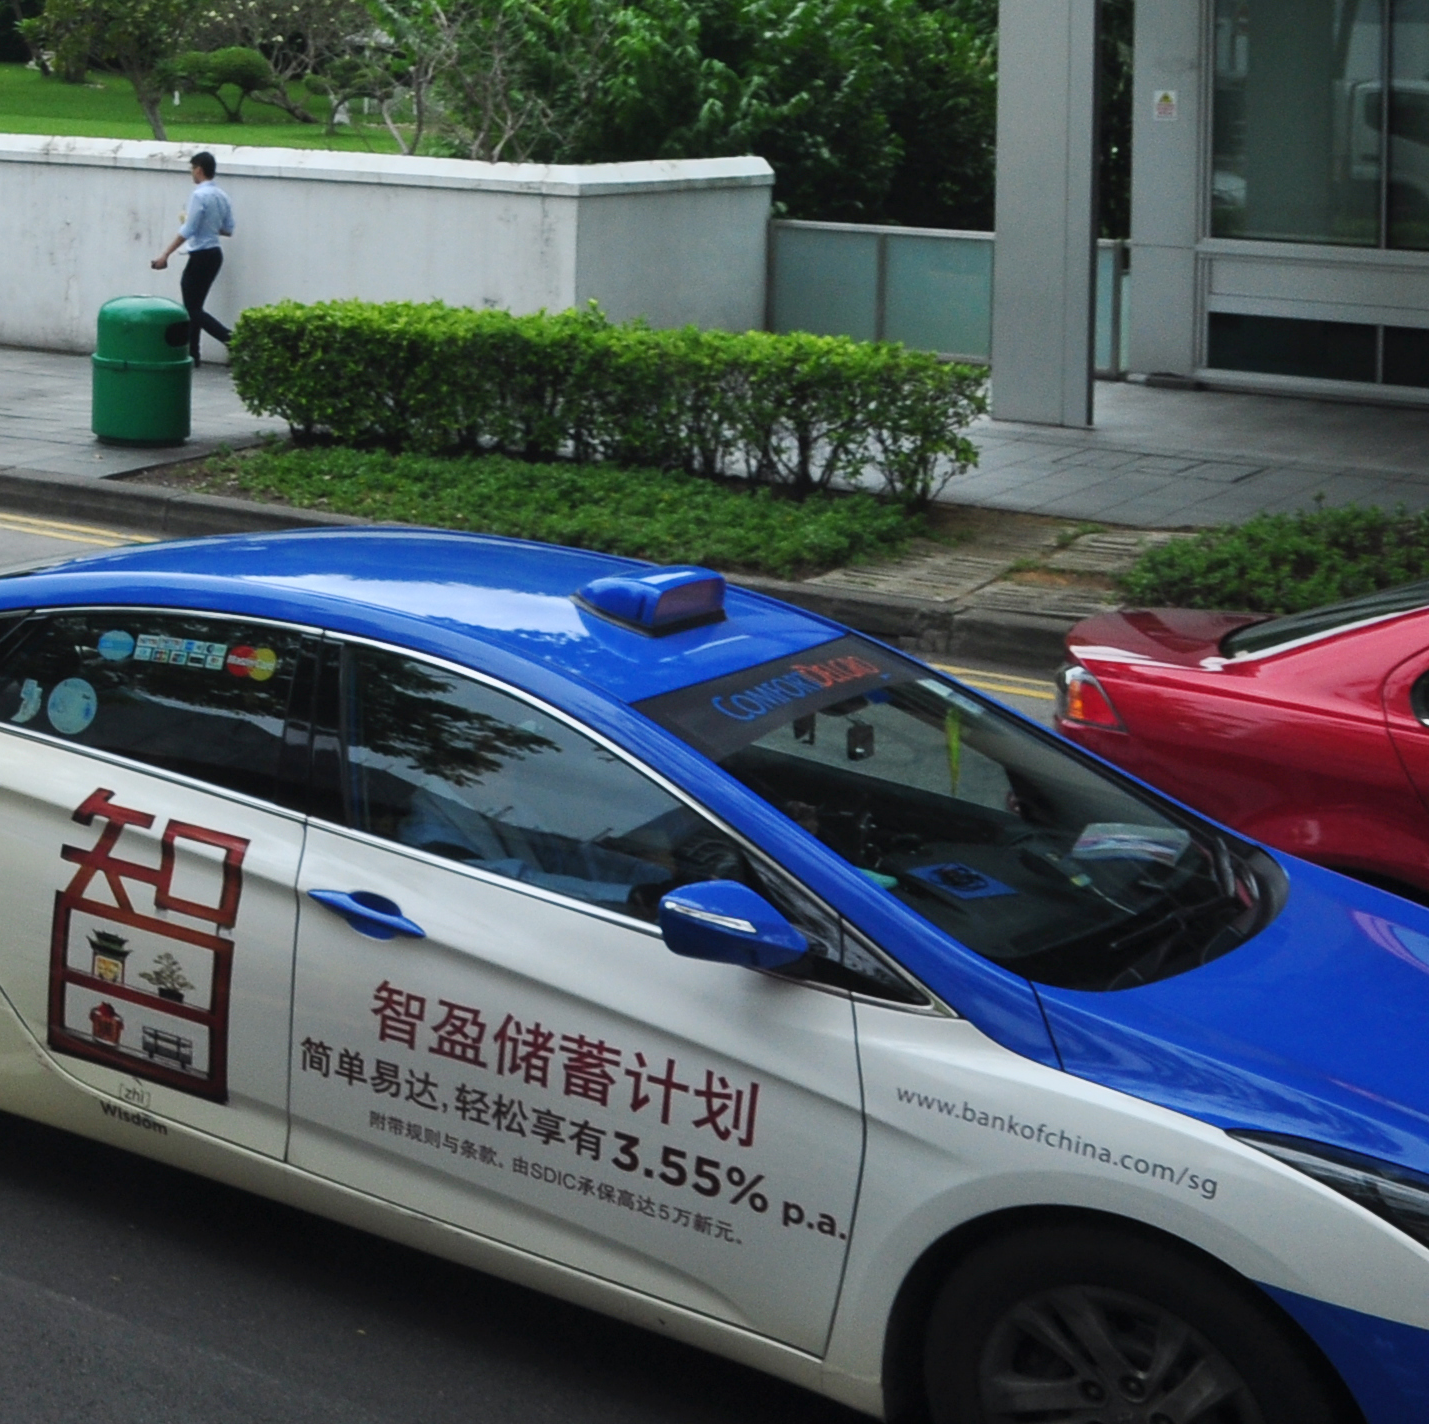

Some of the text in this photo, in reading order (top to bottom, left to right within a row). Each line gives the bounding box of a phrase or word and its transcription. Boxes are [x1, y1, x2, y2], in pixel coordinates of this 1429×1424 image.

[371, 980, 760, 1147] 智盈储蓄计划
[100, 1099, 168, 1135] Wisdom
[897, 1087, 1218, 1200] www.bankofchina.com/sg
[781, 1200, 848, 1240] p.a.
